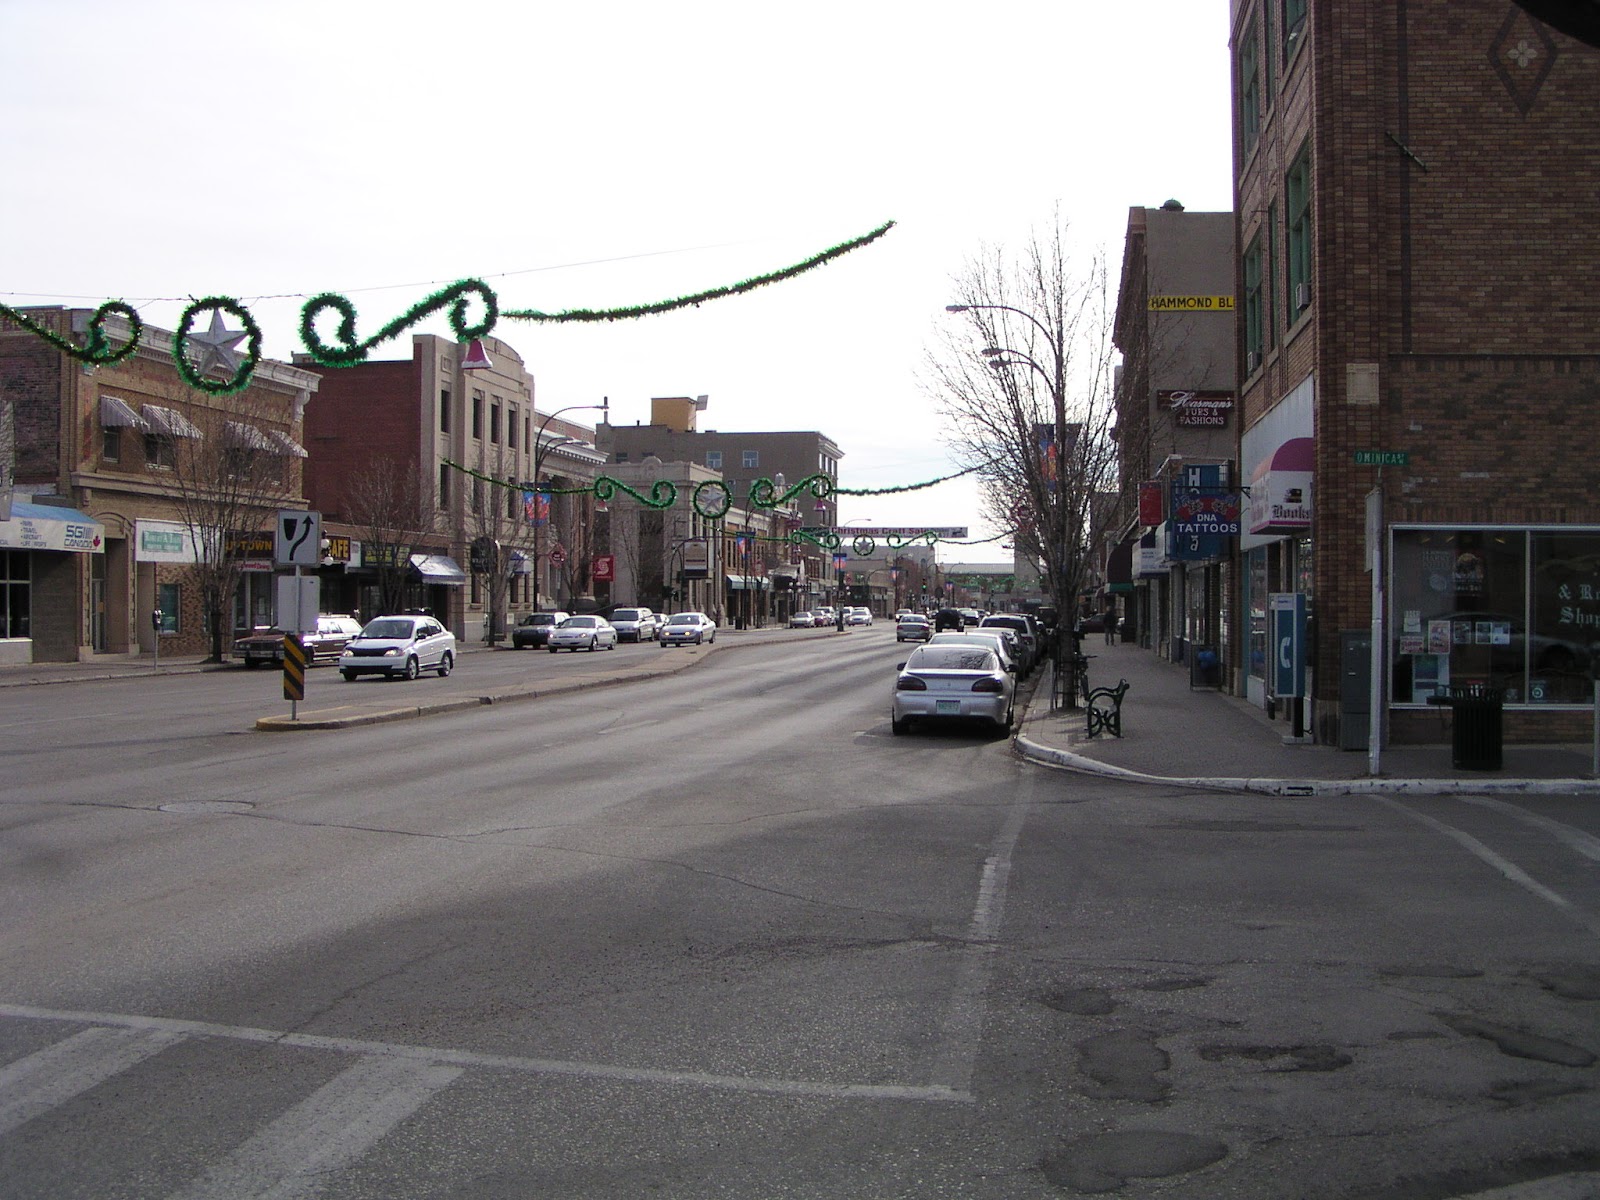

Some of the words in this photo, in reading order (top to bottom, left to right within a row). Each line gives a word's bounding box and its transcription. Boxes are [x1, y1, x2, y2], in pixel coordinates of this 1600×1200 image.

[1151, 297, 1213, 308] HAMMOND
[1180, 416, 1225, 425] FASHIONS
[1197, 513, 1218, 522] DNA
[831, 527, 880, 536] Christmas
[882, 527, 906, 536] Craft
[1177, 523, 1238, 533] TATTOOS
[63, 538, 93, 549] CANADA
[225, 539, 274, 555] UPTOWN
[1558, 583, 1572, 600] &
